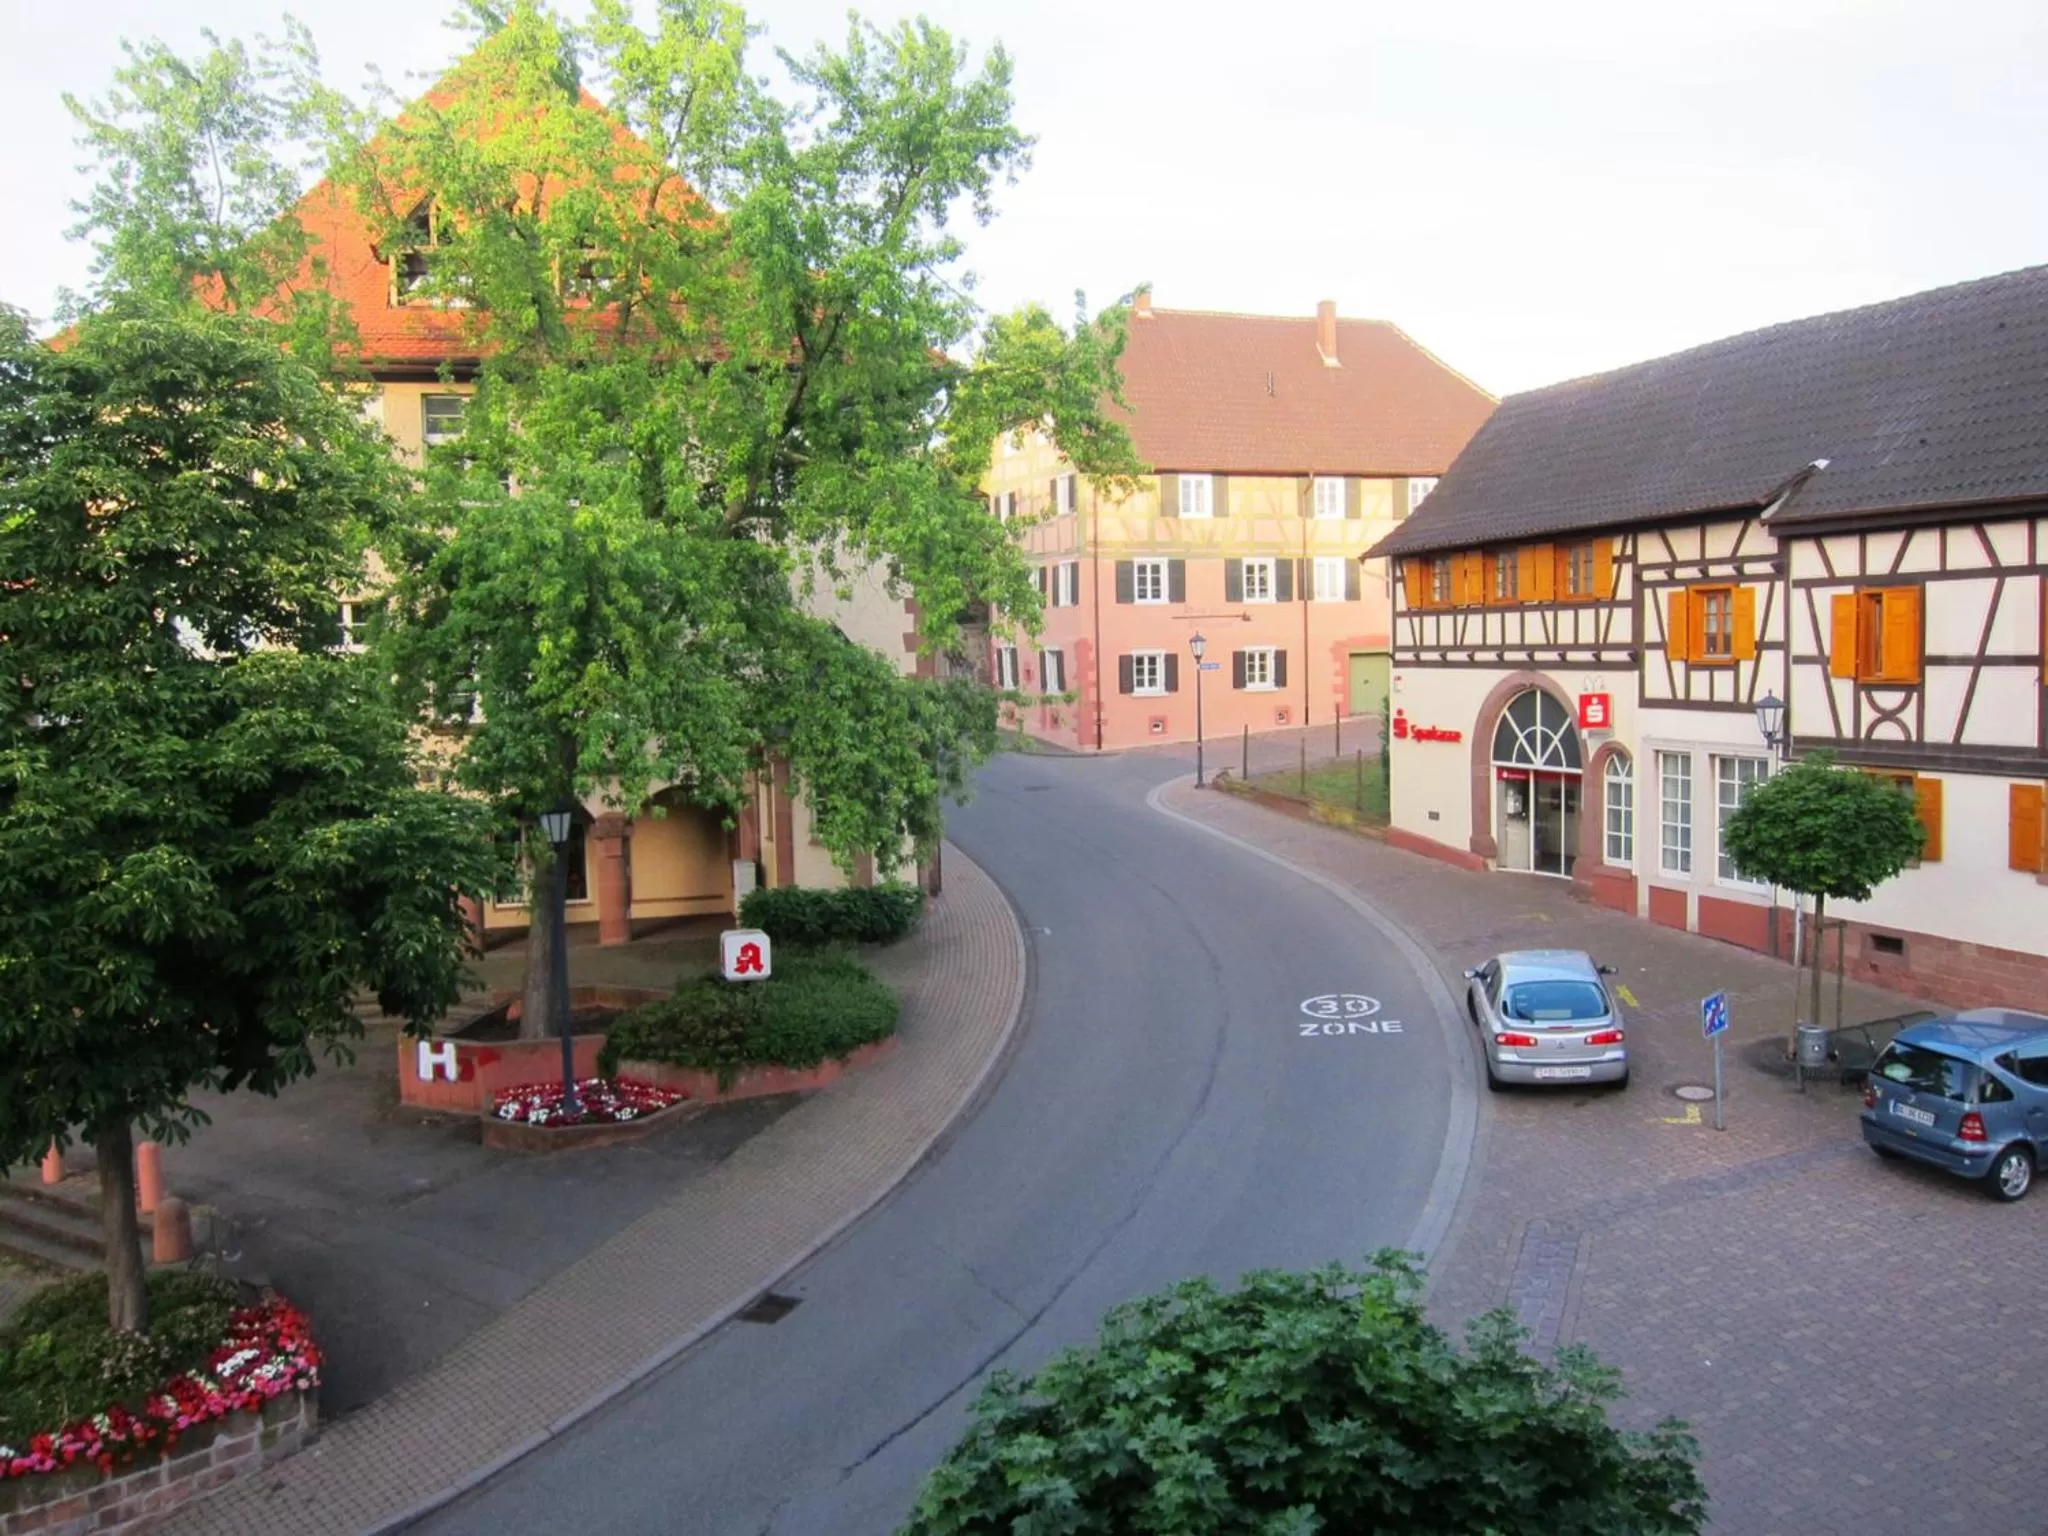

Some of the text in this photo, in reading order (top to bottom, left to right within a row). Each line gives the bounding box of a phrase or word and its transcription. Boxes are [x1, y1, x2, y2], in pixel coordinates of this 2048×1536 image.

[1316, 1000, 1368, 1013] 30
[1299, 1020, 1404, 1036] ZONE
[418, 1040, 457, 1083] H
